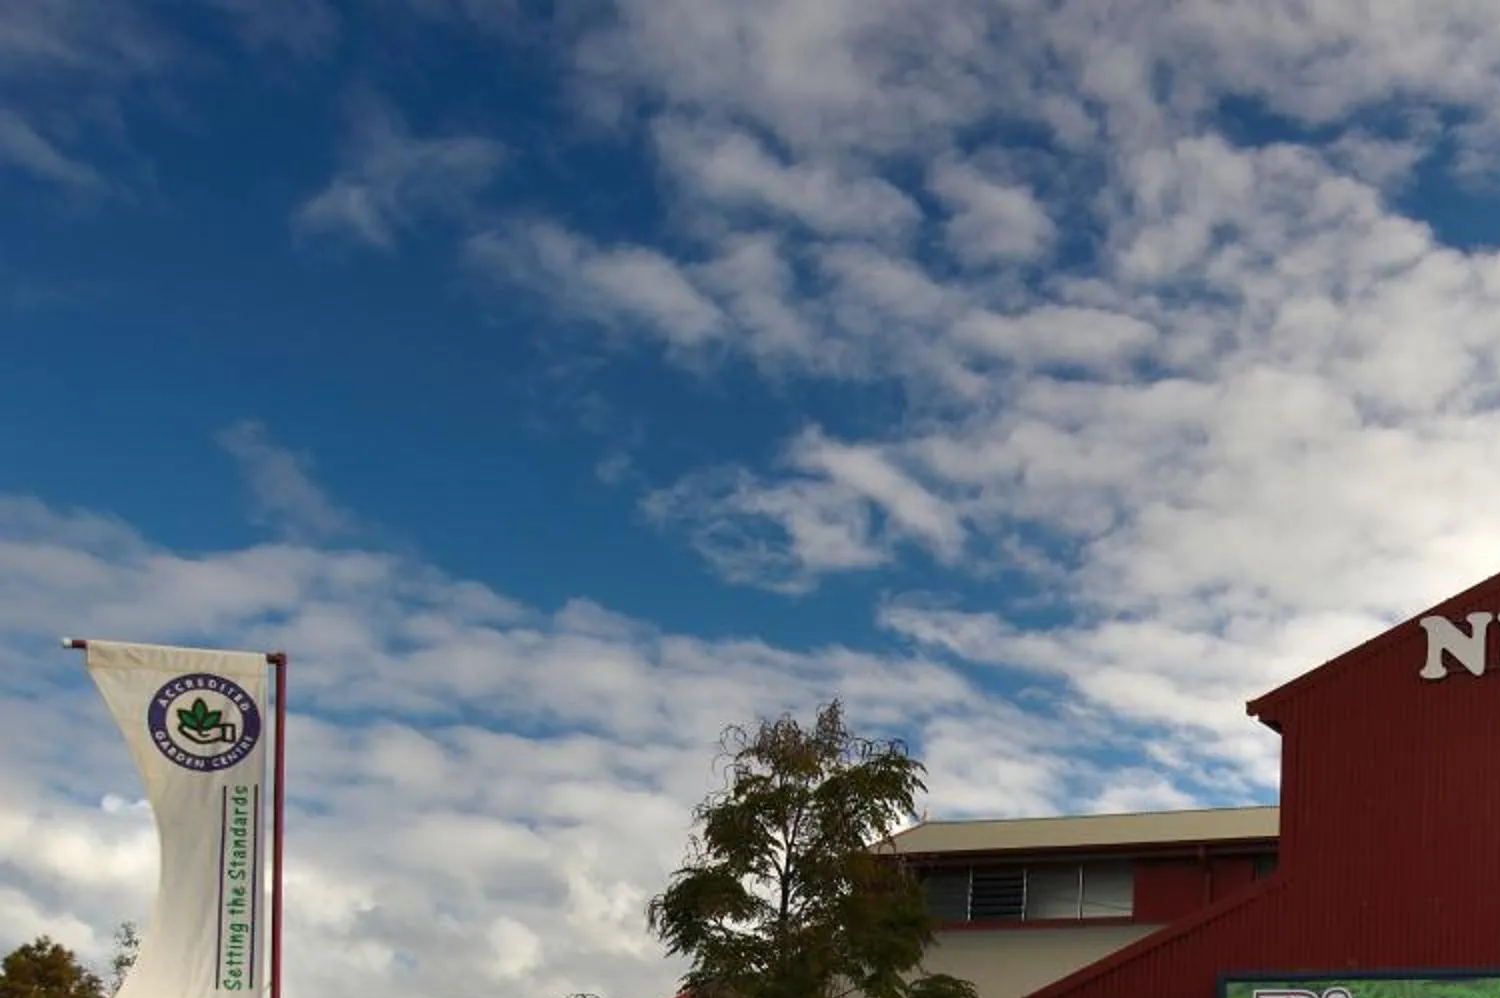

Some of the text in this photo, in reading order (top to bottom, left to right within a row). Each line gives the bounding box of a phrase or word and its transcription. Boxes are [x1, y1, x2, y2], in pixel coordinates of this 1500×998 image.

[223, 785, 249, 990] Setting the Standards
